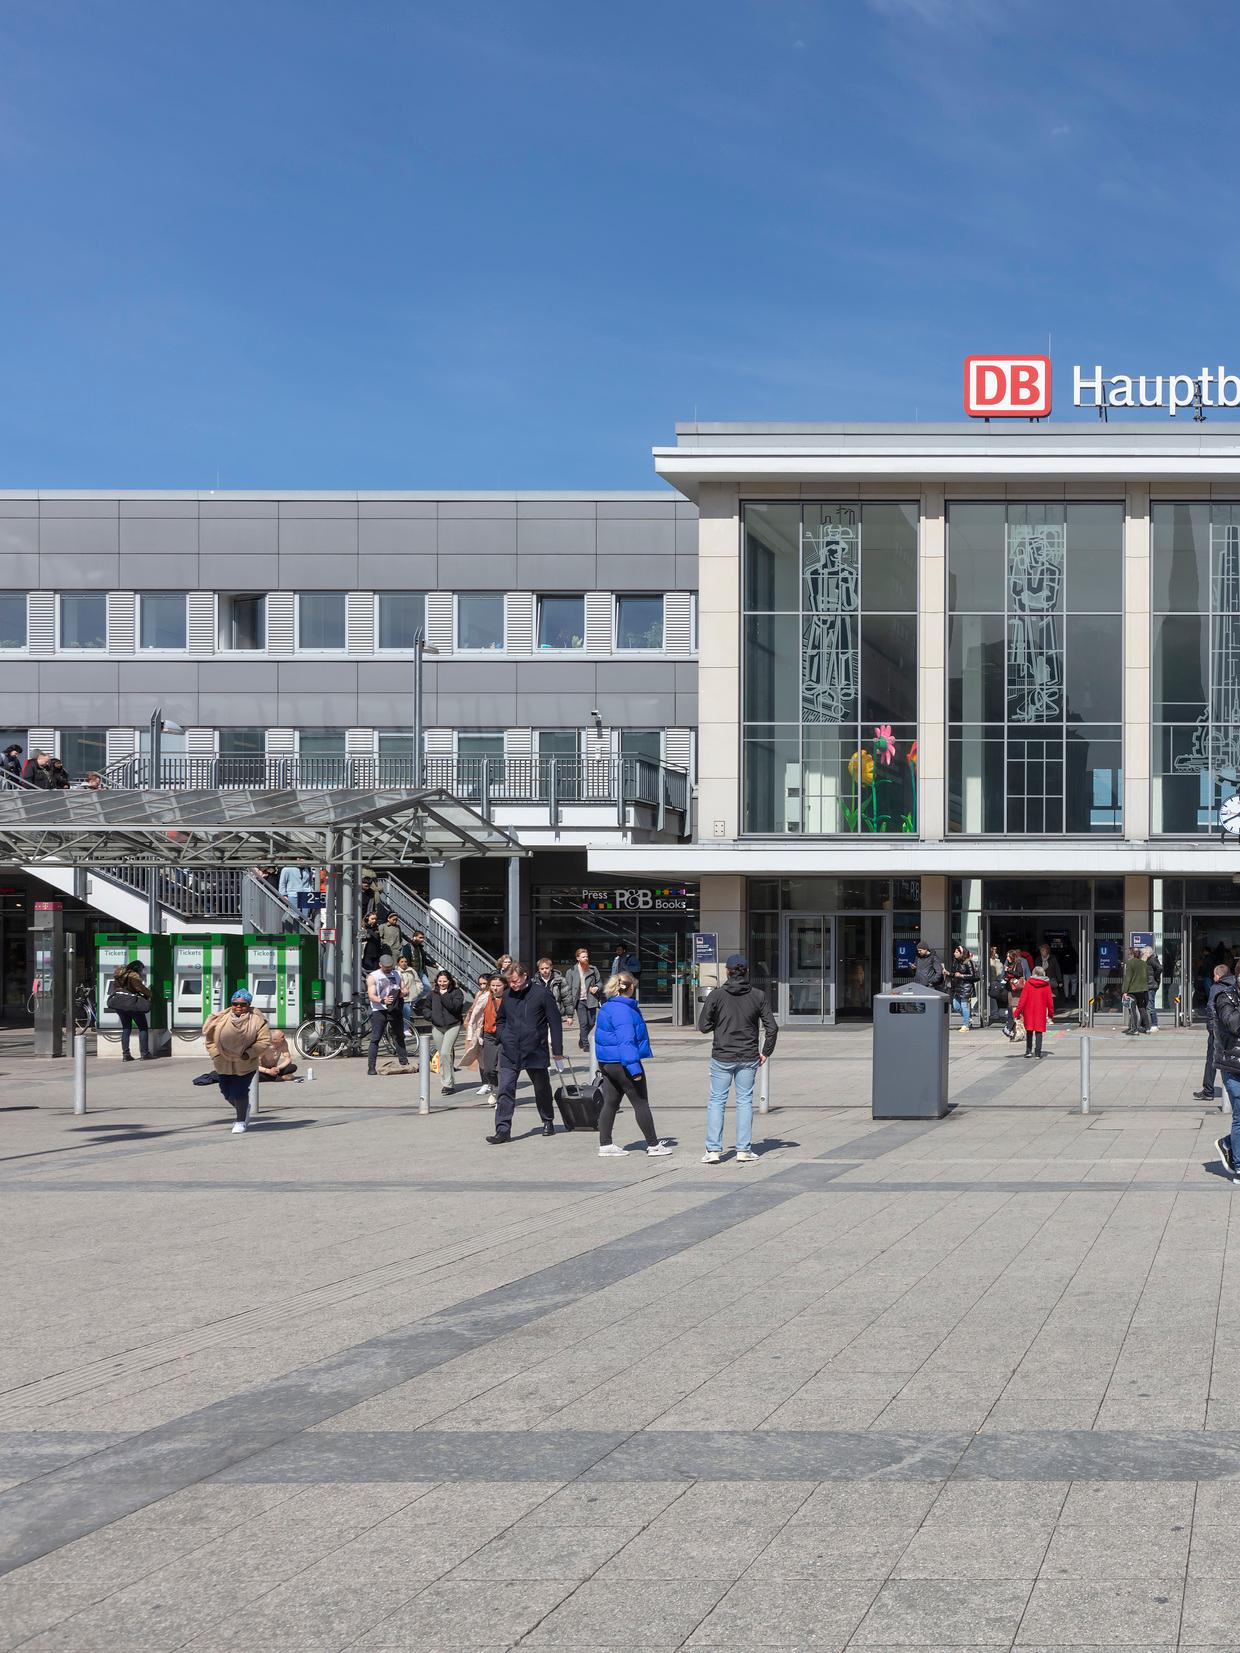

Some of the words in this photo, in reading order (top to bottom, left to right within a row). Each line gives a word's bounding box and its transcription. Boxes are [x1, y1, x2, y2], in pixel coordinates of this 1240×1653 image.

[975, 365, 1041, 405] DB
[306, 892, 327, 904] 2-5
[582, 889, 608, 900] Press
[614, 889, 653, 910] P&B
[655, 899, 686, 910] Books
[104, 949, 127, 957] Tickets
[252, 949, 276, 957] Tickets
[899, 947, 906, 955] U
[1101, 947, 1107, 955] U
